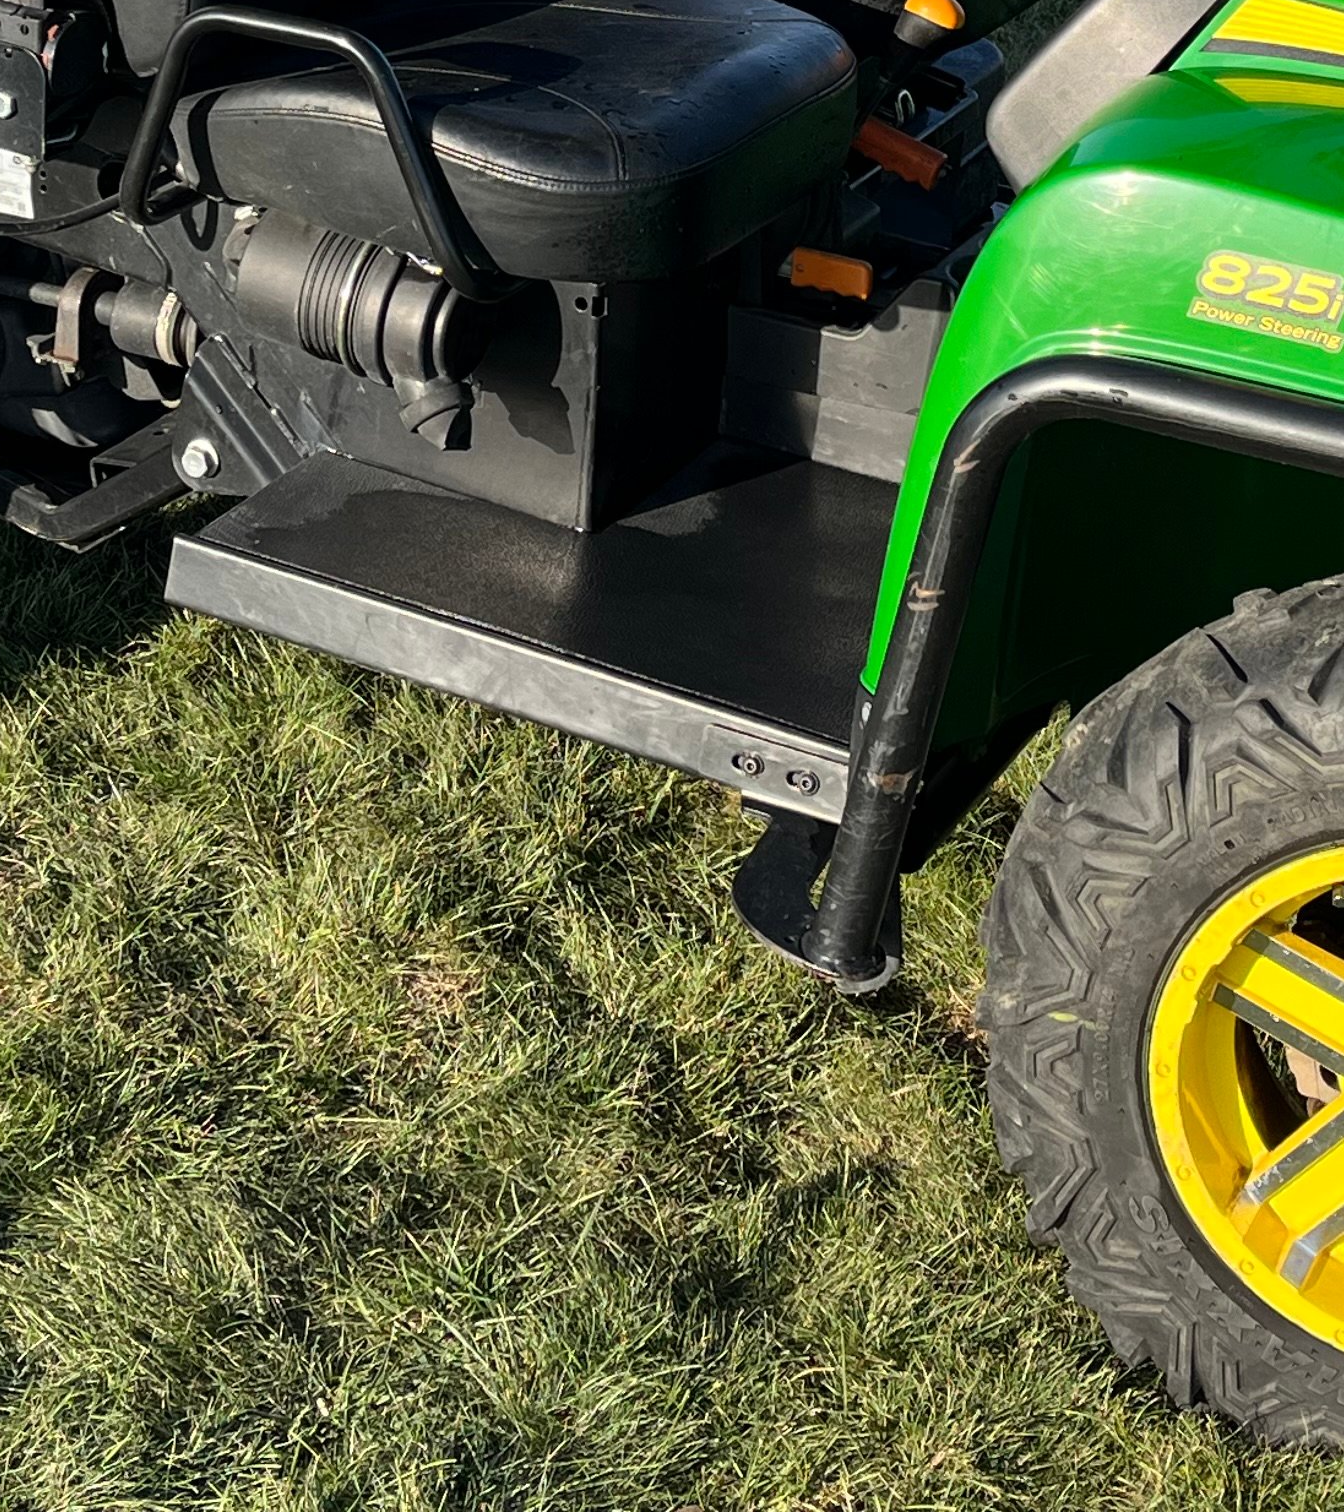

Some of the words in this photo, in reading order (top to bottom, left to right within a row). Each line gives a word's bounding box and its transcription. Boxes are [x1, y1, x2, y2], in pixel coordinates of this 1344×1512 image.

[1200, 253, 1344, 321] 825i
[1191, 299, 1255, 327] Power
[1258, 315, 1343, 351] Steering
